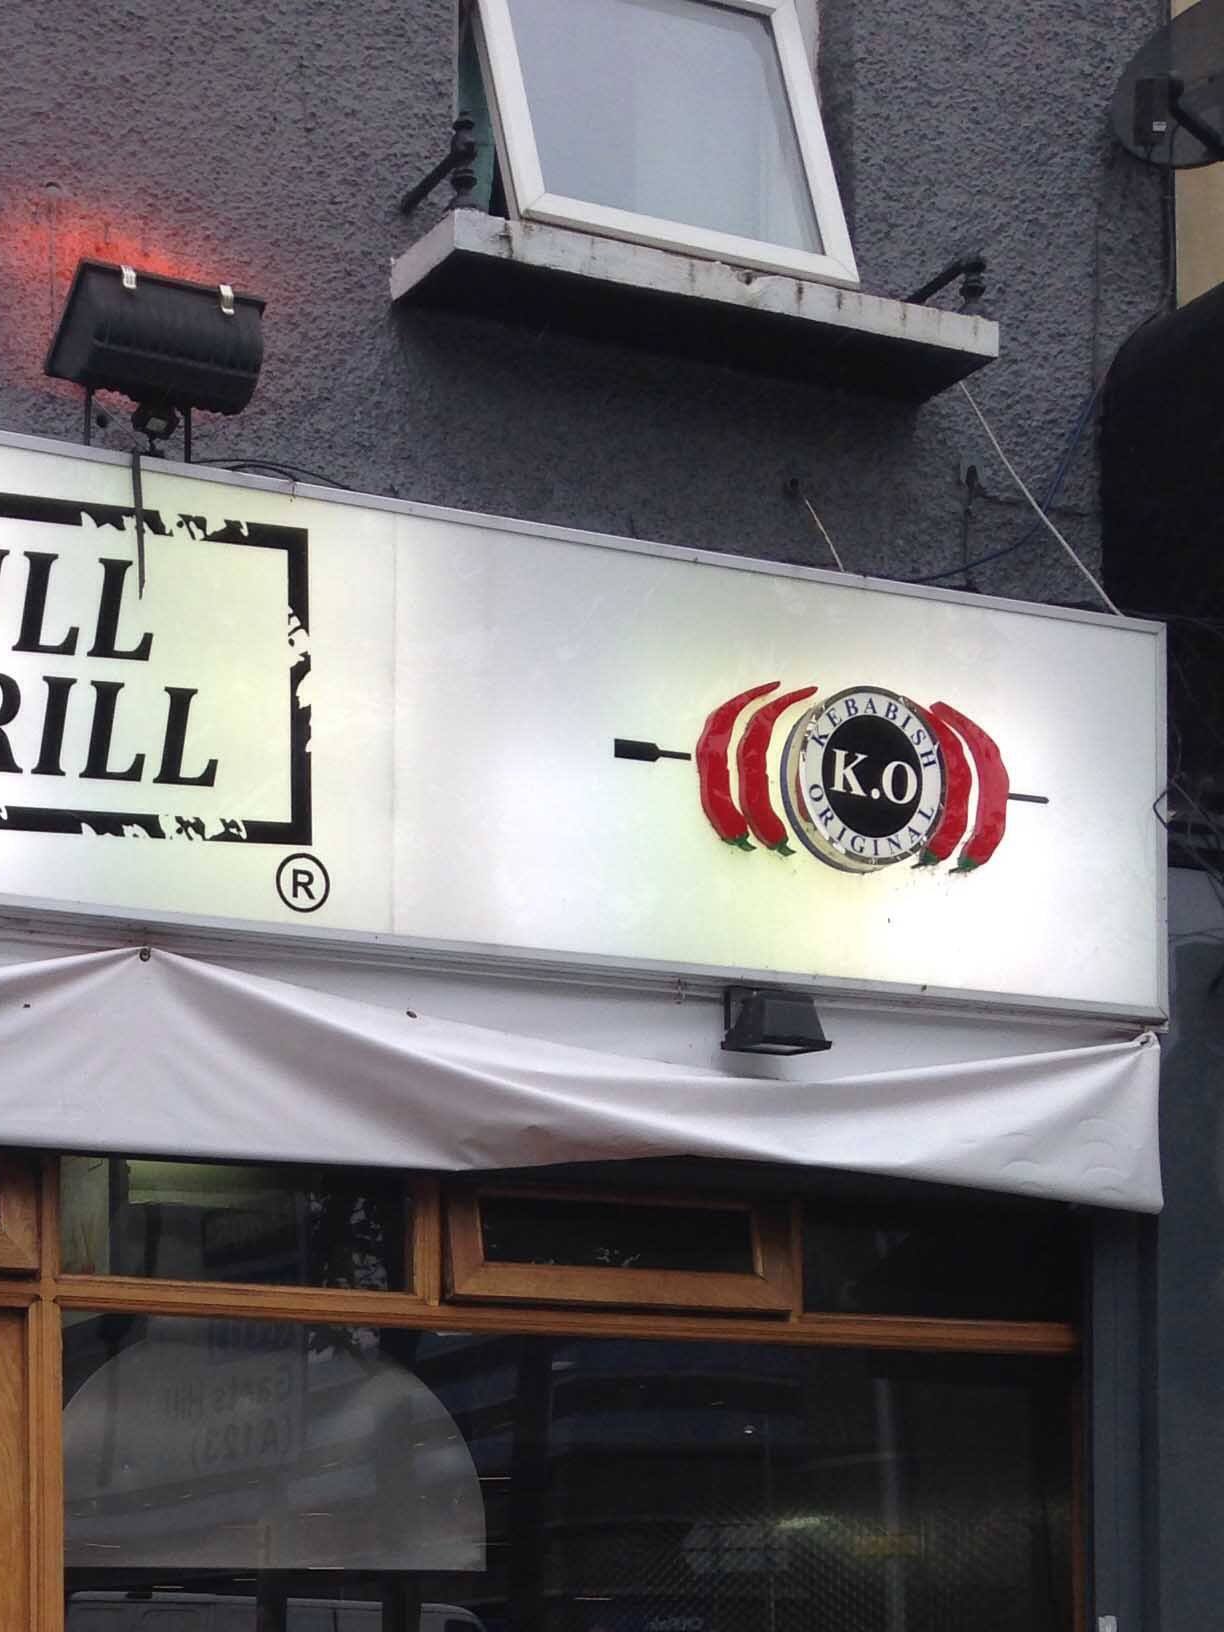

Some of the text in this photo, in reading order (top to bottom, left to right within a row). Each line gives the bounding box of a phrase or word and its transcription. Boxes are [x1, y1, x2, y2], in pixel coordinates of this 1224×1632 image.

[812, 697, 937, 769] KEBABISH
[829, 748, 918, 805] K.O
[809, 783, 935, 856] ORIGINAL
